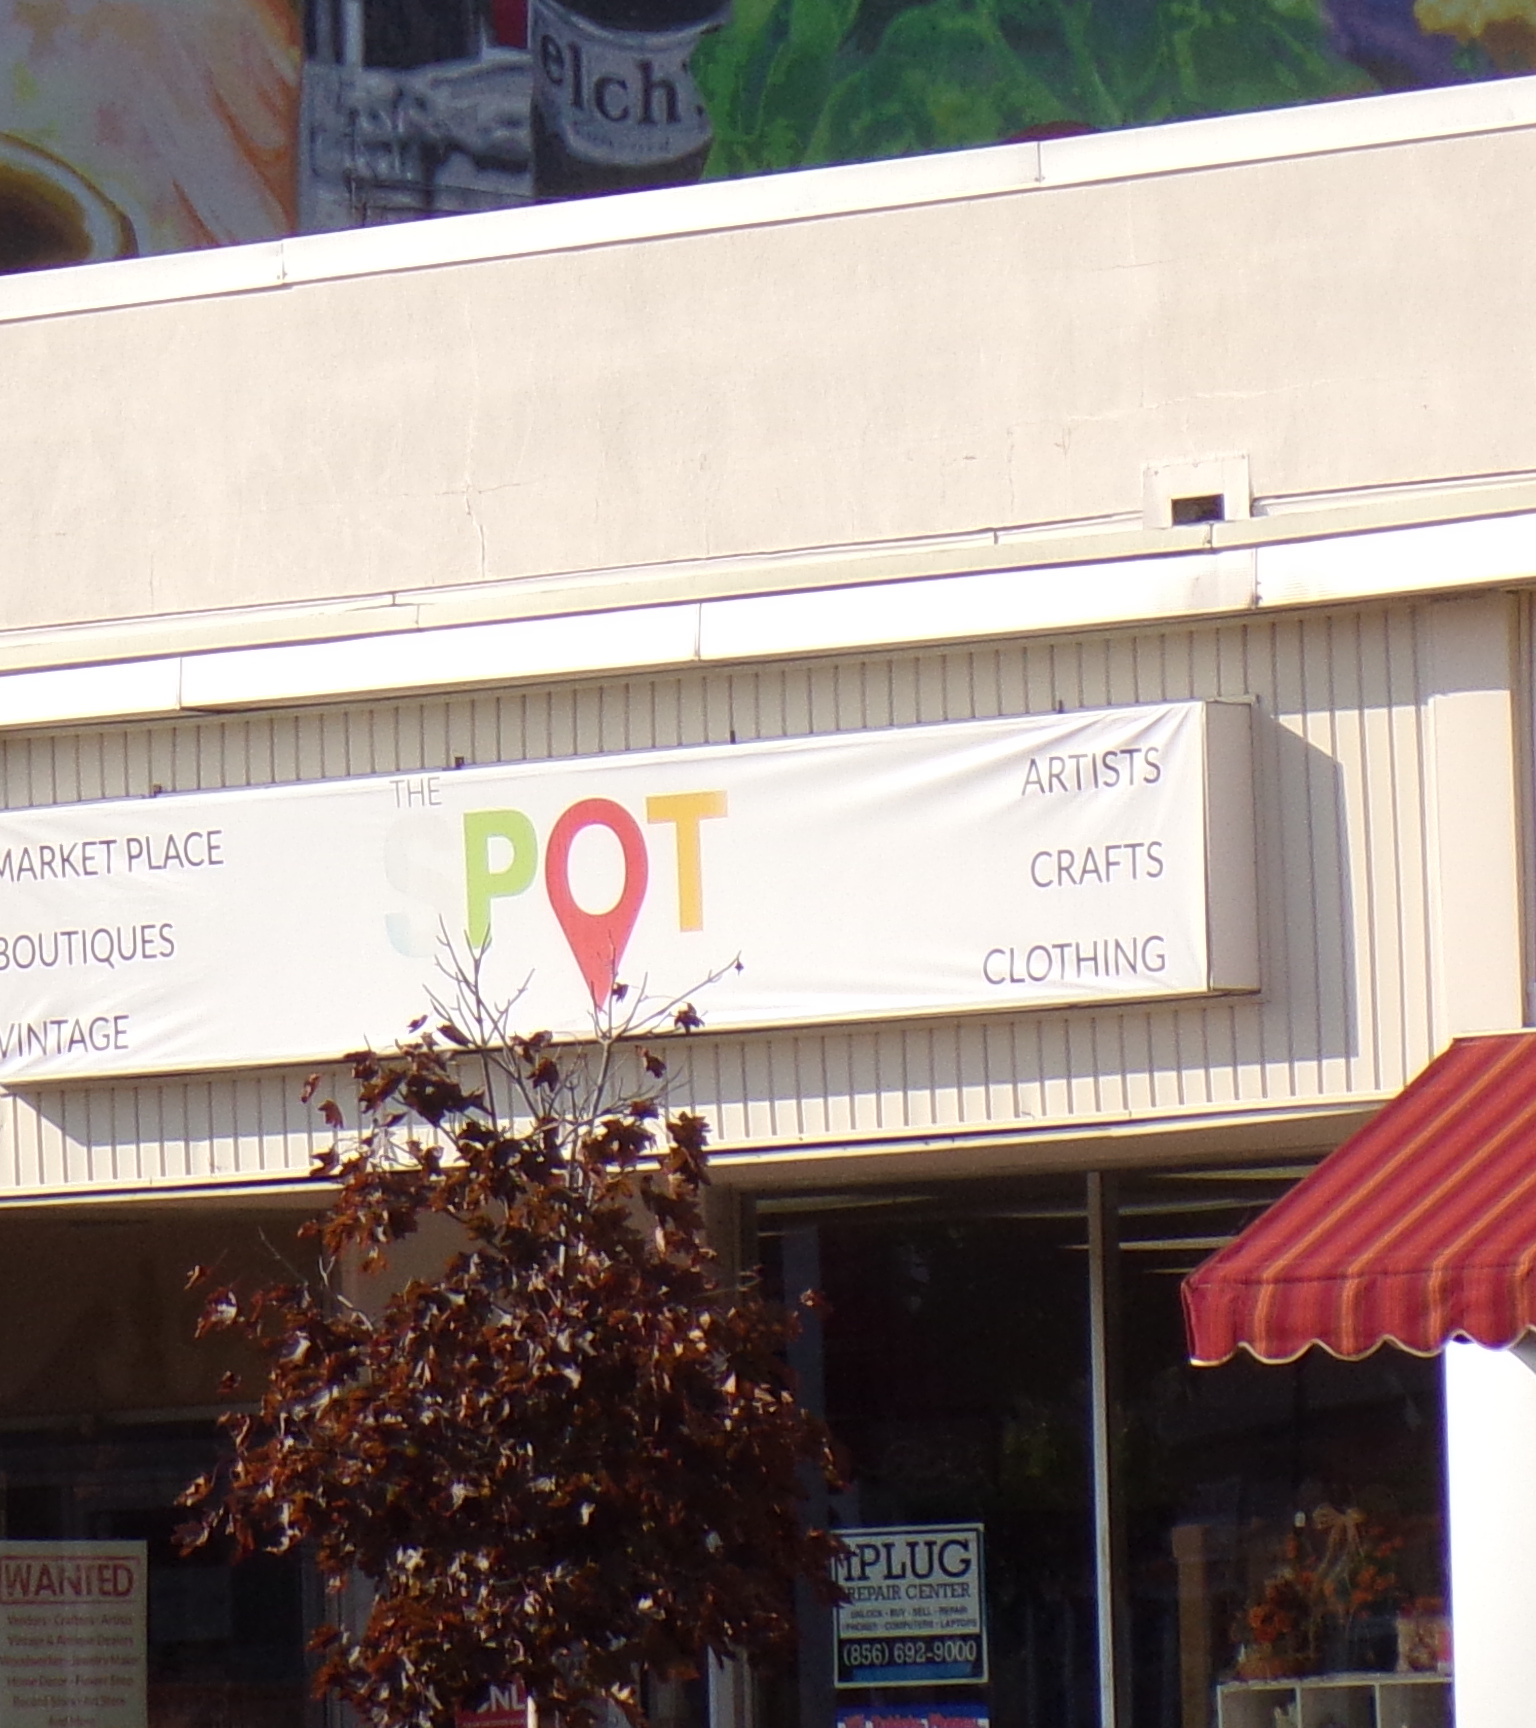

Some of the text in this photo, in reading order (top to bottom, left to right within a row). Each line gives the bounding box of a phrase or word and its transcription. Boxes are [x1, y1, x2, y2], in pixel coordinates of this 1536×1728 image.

[1022, 747, 1161, 796] ARTISTS
[390, 777, 442, 809] THE
[126, 830, 224, 872] PLACE
[1031, 841, 1163, 887] CRAFTS
[983, 936, 1165, 985] CLOTHING
[5, 1563, 134, 1597] WANTED
[847, 1582, 971, 1602] REPAIR CENTER
[843, 1640, 977, 1666] (856) 692-9000
